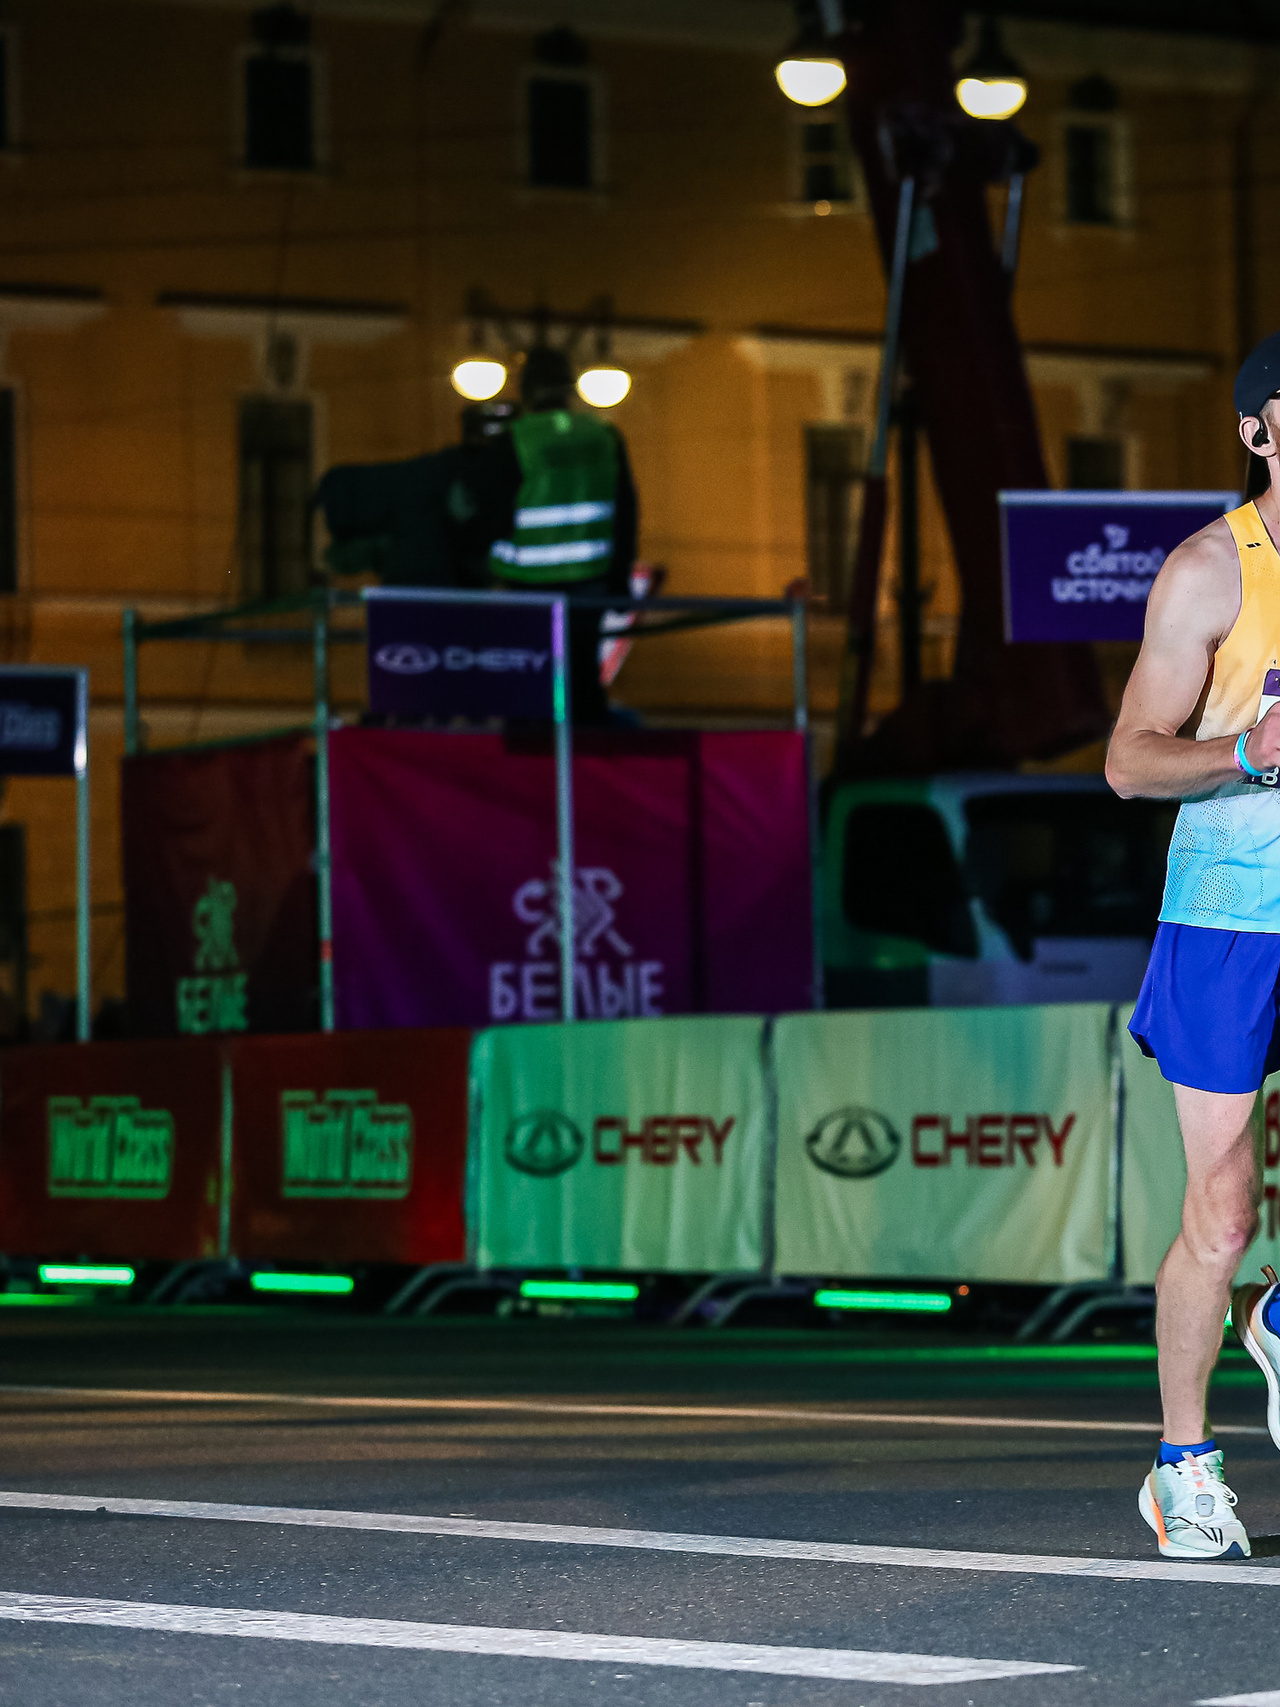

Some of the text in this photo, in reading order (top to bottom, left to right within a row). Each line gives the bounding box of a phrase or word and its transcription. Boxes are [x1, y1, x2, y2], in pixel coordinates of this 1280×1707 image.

[444, 646, 549, 671] CHERY
[489, 961, 664, 1019] БЕЛЫЕ
[594, 1114, 735, 1167] CHERY
[911, 1112, 1076, 1168] CHERY
